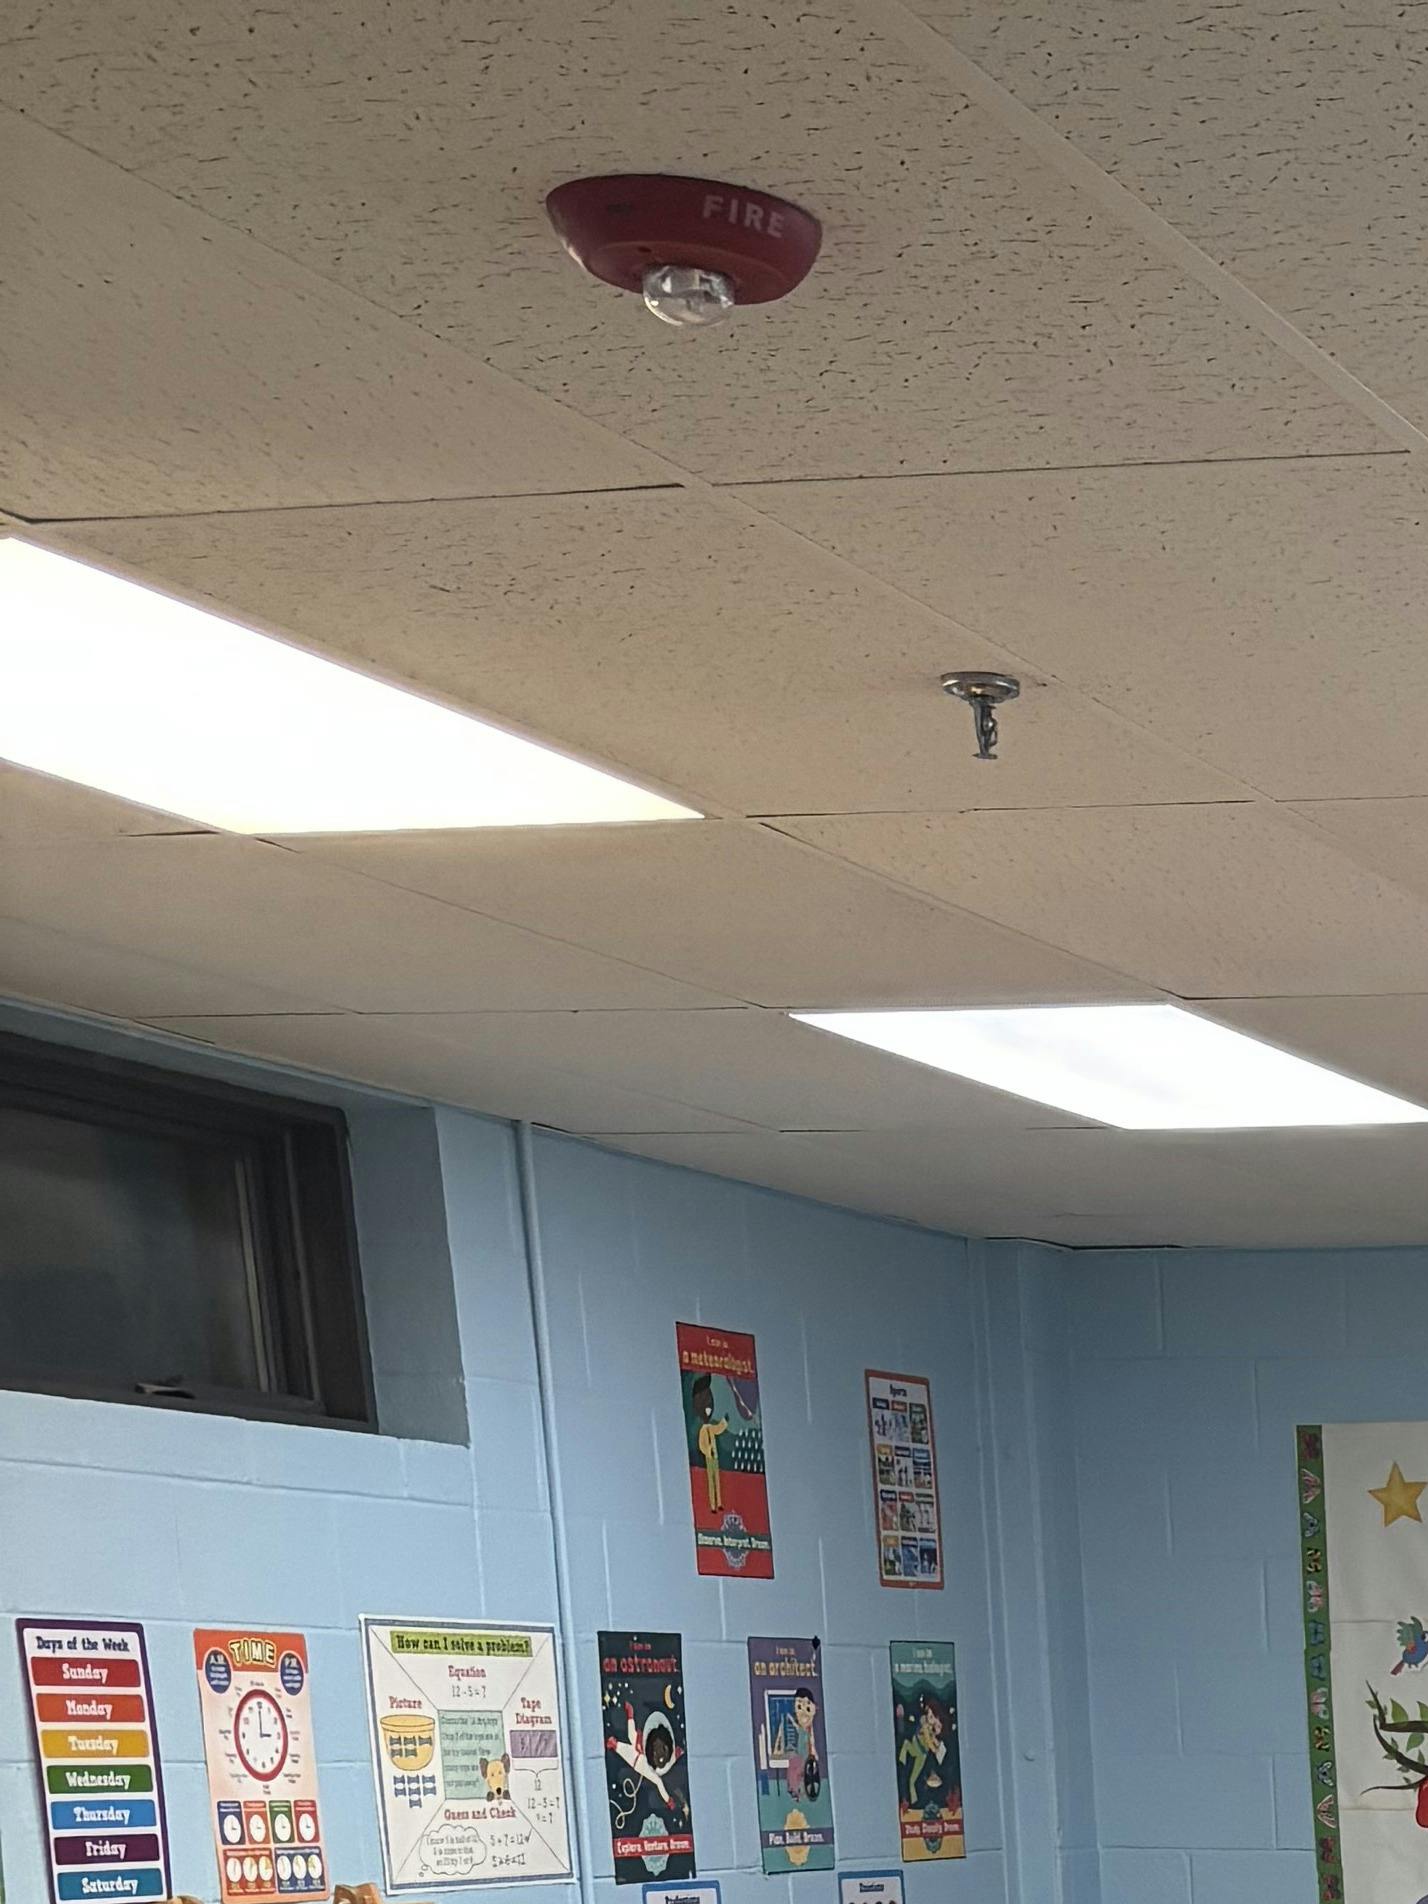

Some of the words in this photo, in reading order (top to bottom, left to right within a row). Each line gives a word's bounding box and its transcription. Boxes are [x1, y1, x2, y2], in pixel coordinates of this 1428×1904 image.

[702, 195, 786, 239] FIRE
[36, 1636, 63, 1653] Days
[66, 1636, 77, 1650] of
[82, 1637, 98, 1651] the
[102, 1638, 130, 1652] Week
[229, 1640, 276, 1666] TIME
[396, 1635, 420, 1649] How
[424, 1637, 440, 1650] can
[450, 1637, 475, 1651] solve
[486, 1638, 530, 1655] problem?
[62, 1663, 108, 1684] Sunday
[448, 1665, 486, 1681] Equation
[754, 1661, 767, 1675] an
[66, 1699, 112, 1720] Monday
[389, 1696, 422, 1709] Picture
[521, 1697, 541, 1712] Tape
[515, 1712, 552, 1727] Diagram
[68, 1735, 118, 1755] Tuesday
[66, 1772, 131, 1790] Wednesday
[73, 1806, 130, 1826] Thursday
[444, 1808, 470, 1821] Guess
[472, 1808, 487, 1820] and
[489, 1807, 516, 1819] Check
[85, 1841, 126, 1862] Friday
[82, 1877, 138, 1896] Saturday
